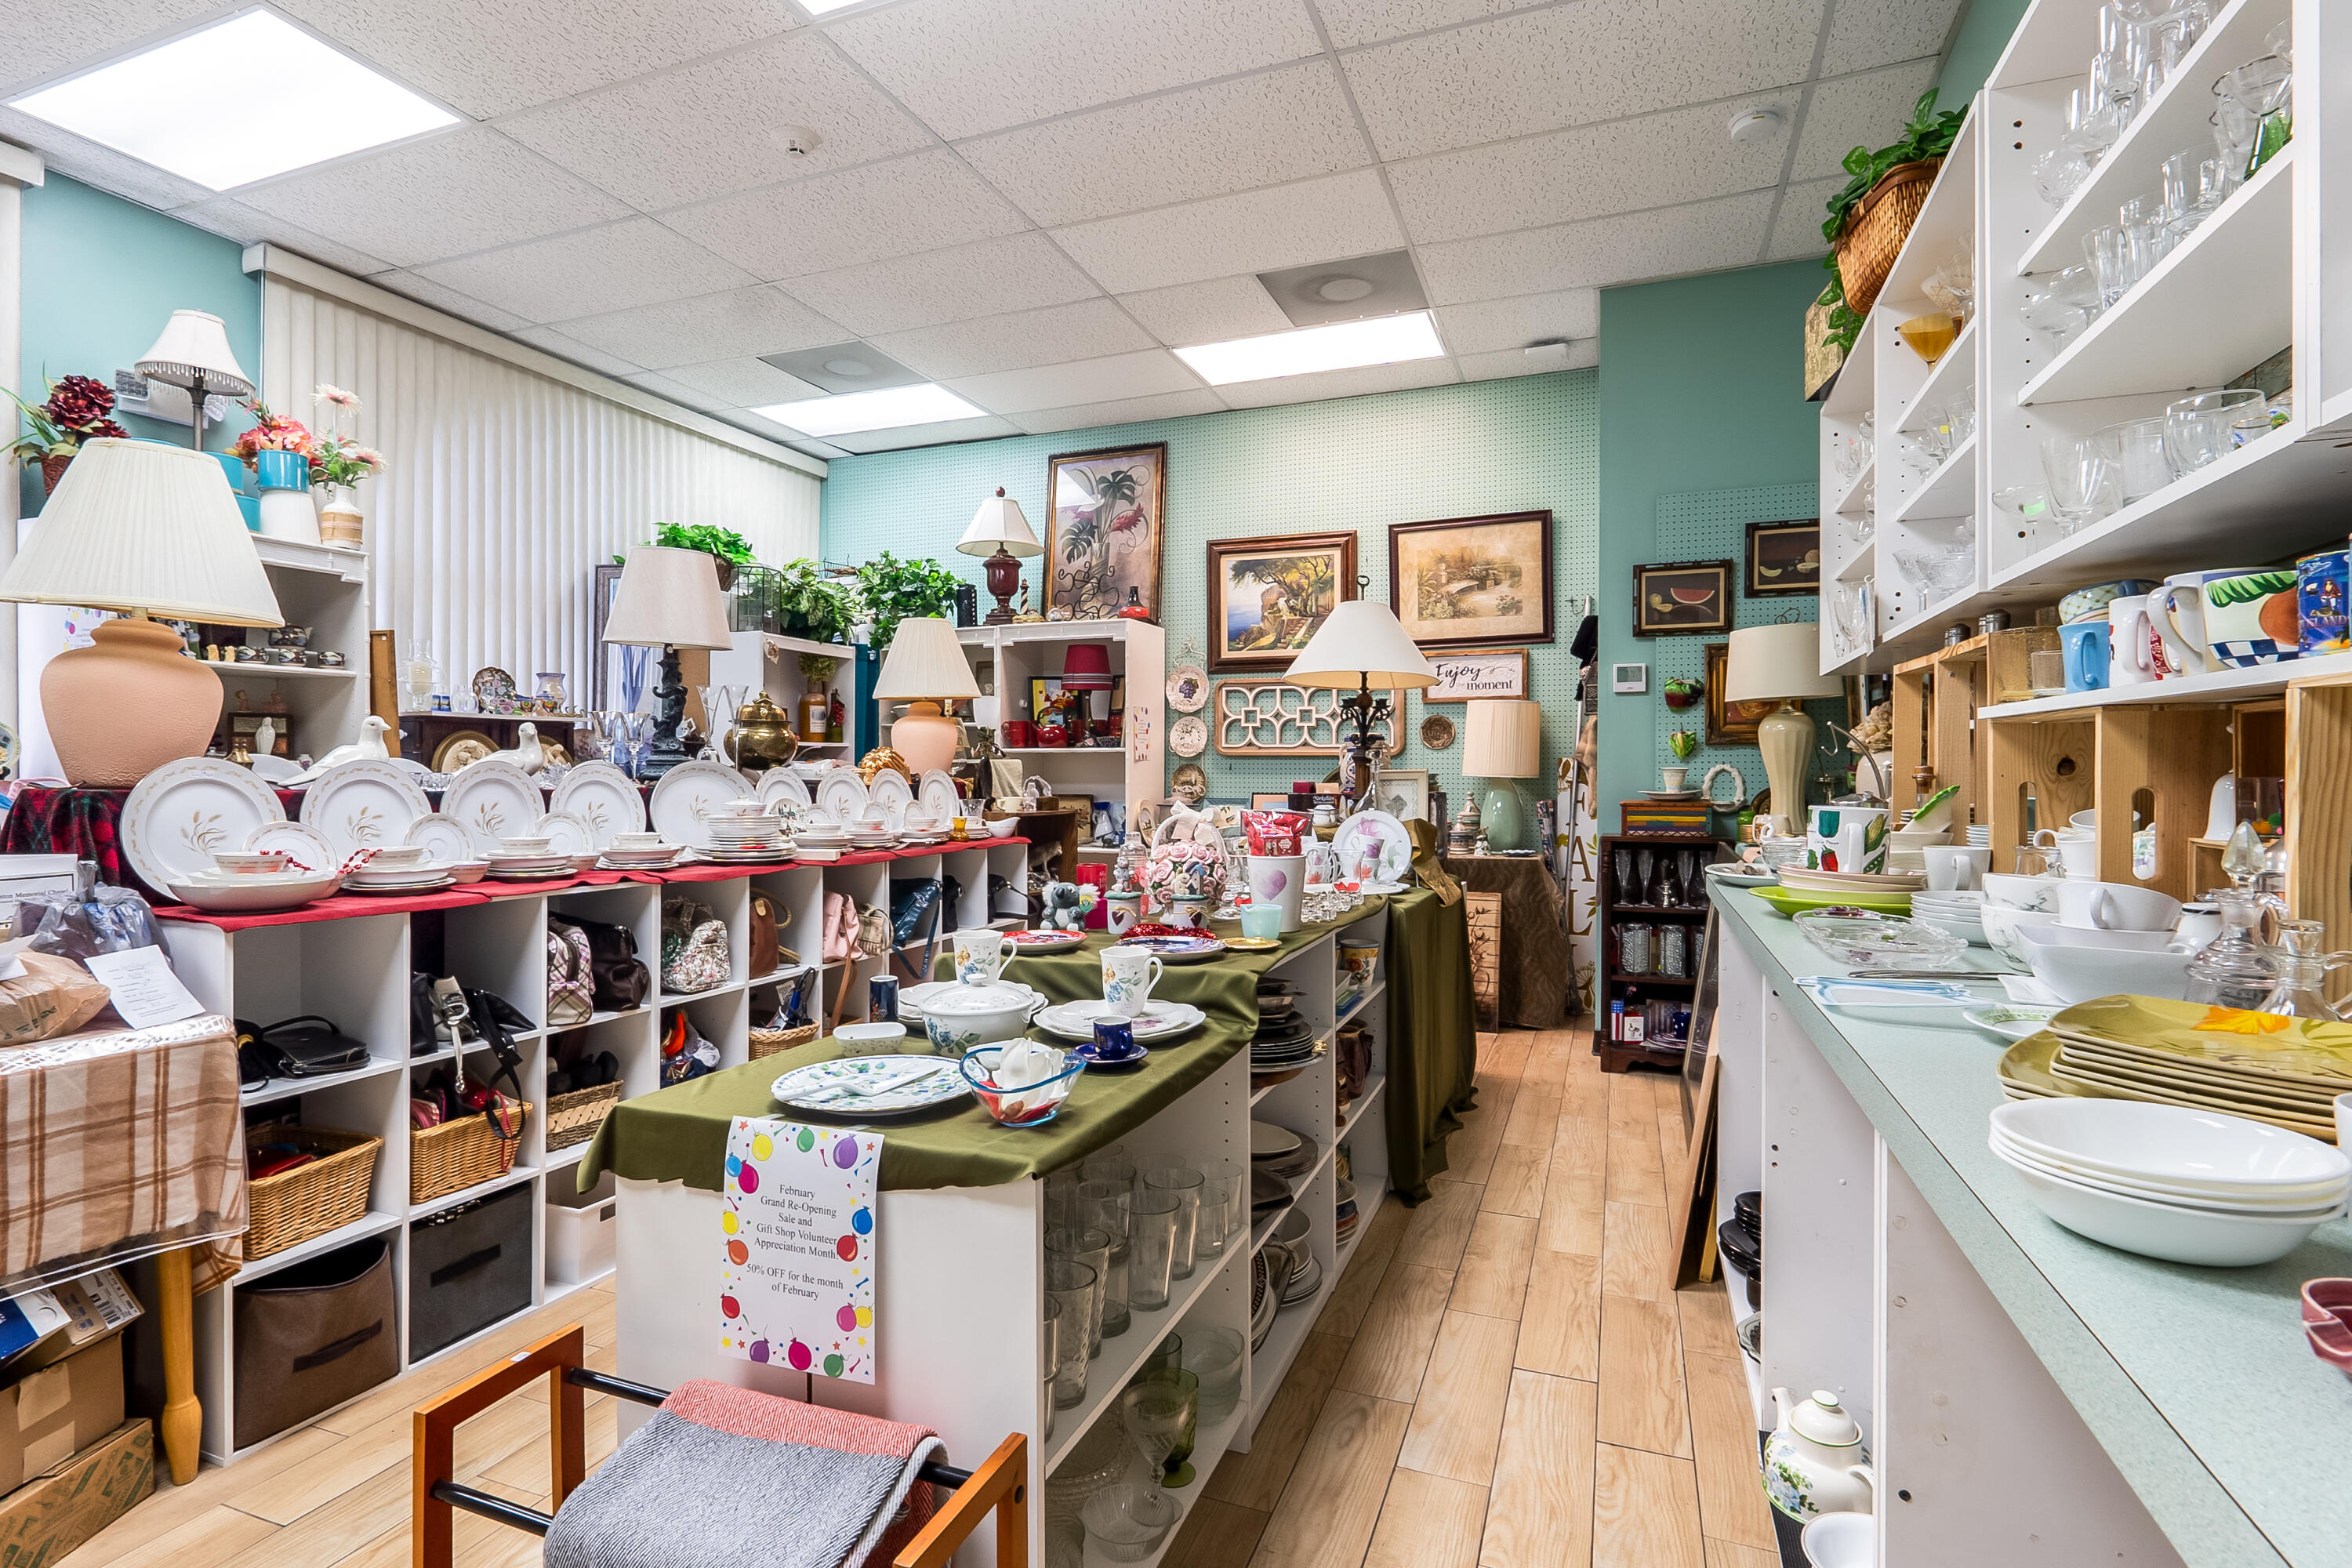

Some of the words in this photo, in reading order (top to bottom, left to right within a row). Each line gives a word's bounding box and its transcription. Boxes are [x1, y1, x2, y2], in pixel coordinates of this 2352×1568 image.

[1436, 662, 1494, 688] Enjoy
[1467, 680, 1512, 691] moment
[779, 1185, 815, 1201] February
[760, 1196, 786, 1208] Grand
[788, 1200, 837, 1219] Re-Opening
[778, 1213, 796, 1225] Sale
[797, 1216, 813, 1228] and
[756, 1223, 774, 1235] Gift
[775, 1225, 796, 1240] Shop
[798, 1229, 837, 1246] Volunteer
[754, 1237, 806, 1254] Appreciation
[808, 1245, 839, 1260] Month!
[746, 1263, 765, 1276] 50%
[767, 1266, 786, 1279] OFF
[787, 1269, 800, 1282] for
[801, 1272, 815, 1283] the
[817, 1277, 844, 1290] month
[771, 1282, 782, 1292] of
[782, 1284, 819, 1301] February
